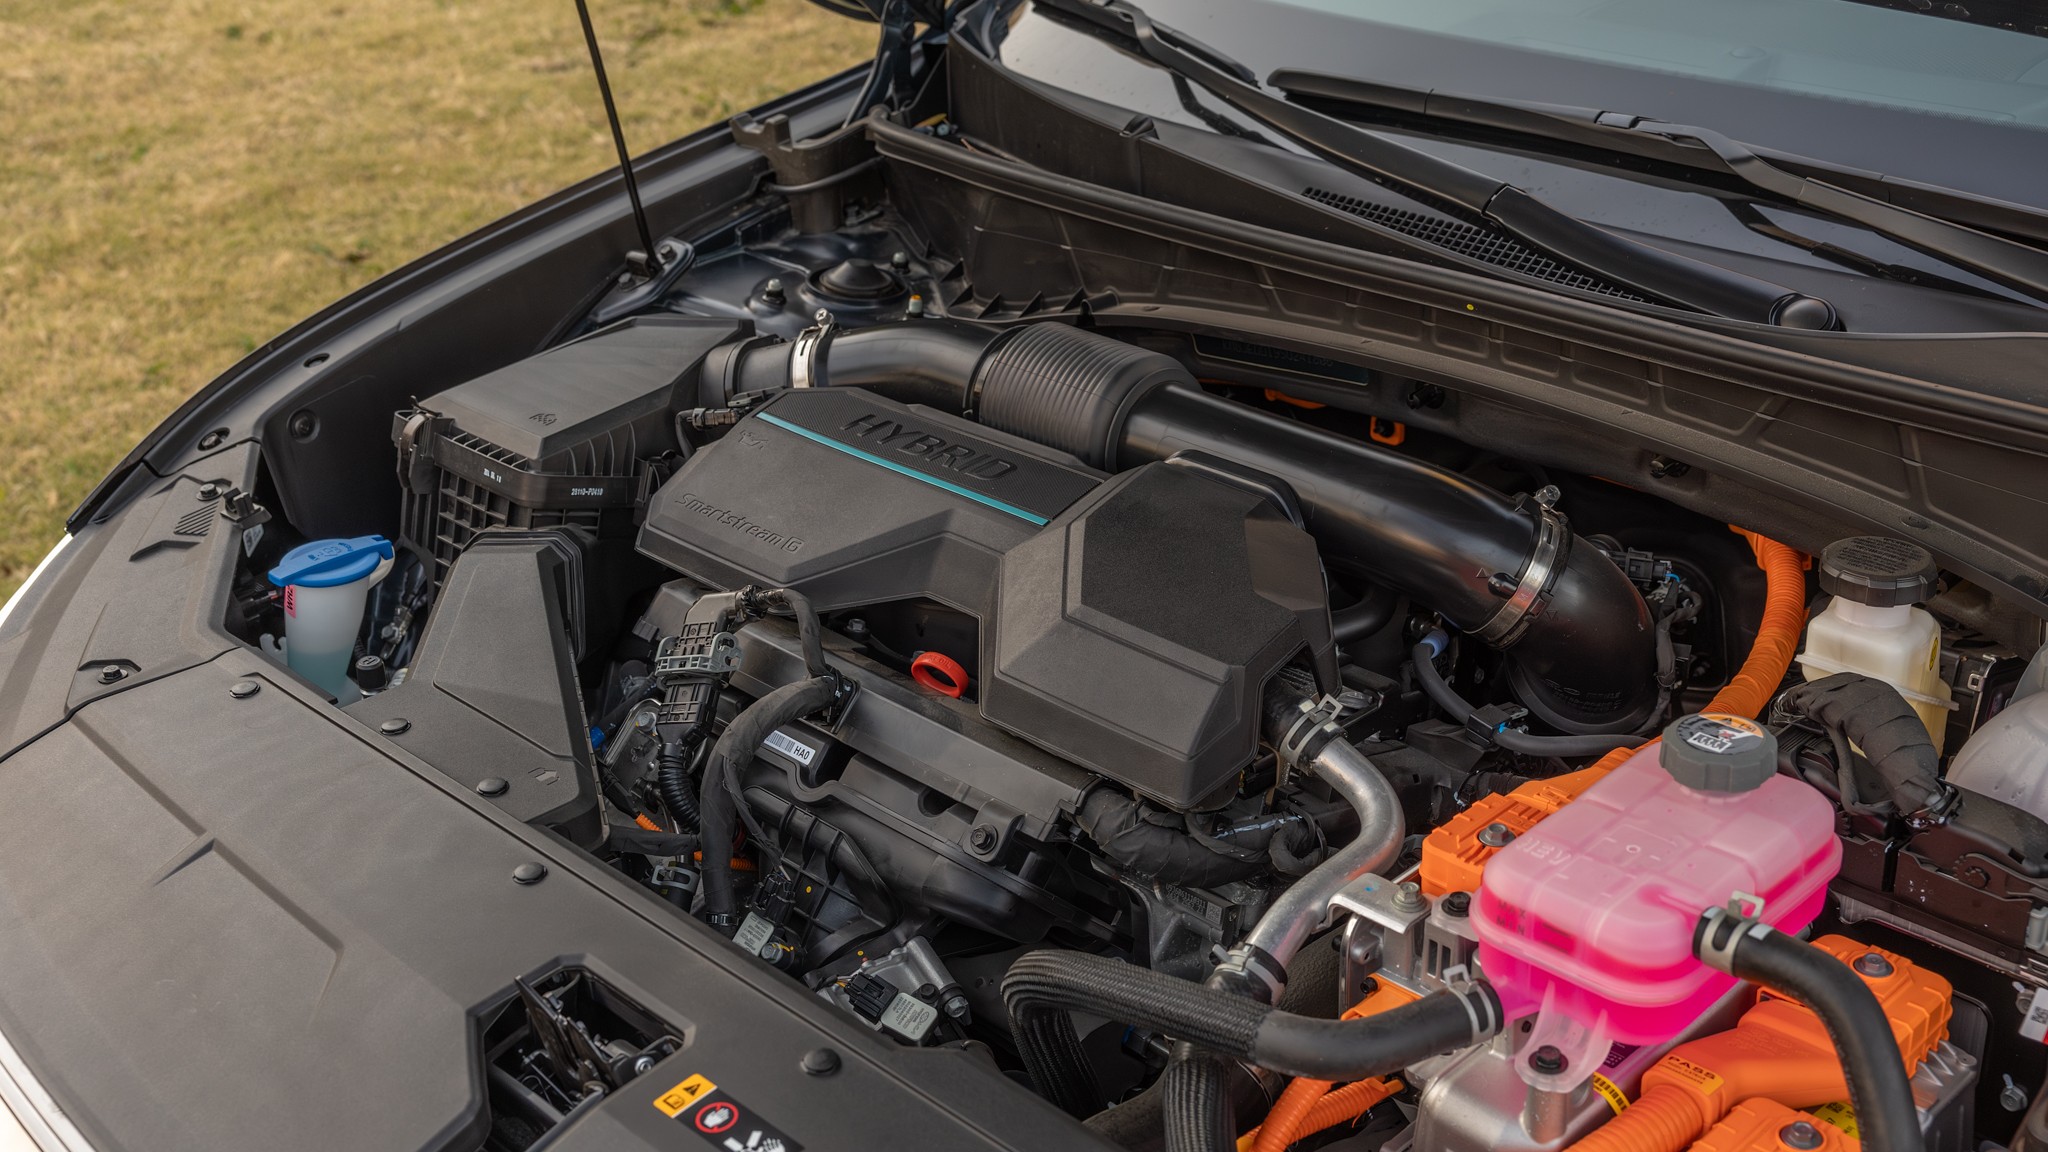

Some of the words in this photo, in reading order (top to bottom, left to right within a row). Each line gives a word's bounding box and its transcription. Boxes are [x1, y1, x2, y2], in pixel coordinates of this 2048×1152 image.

[839, 414, 1018, 481] HYBRID
[674, 492, 785, 549] Smartstream
[1496, 915, 1526, 937] MIN
[1497, 899, 1527, 919] MAX
